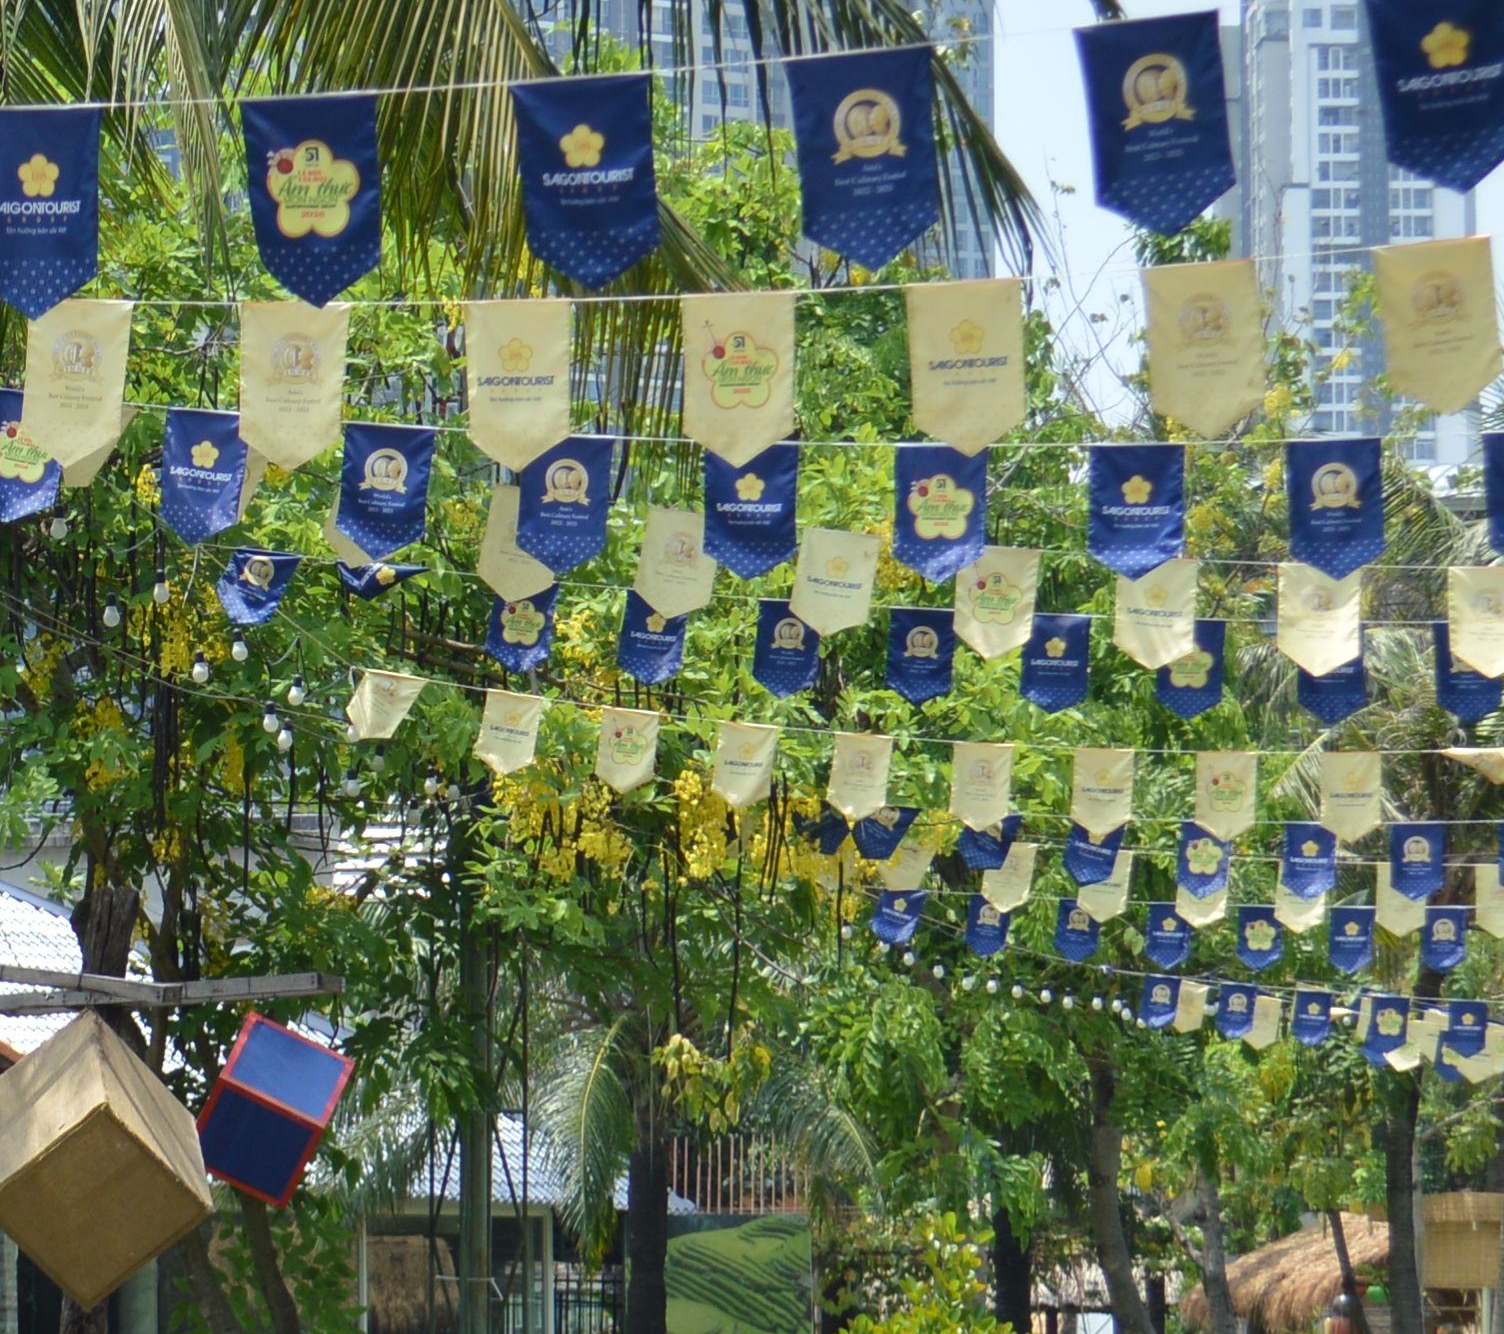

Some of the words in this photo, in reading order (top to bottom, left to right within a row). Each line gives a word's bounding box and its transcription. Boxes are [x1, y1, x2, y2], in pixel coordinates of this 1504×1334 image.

[542, 167, 635, 186] SAIGONTOURIST
[278, 175, 312, 203] Ẩm
[928, 356, 1008, 370] SAIGONTOURIST
[477, 376, 554, 386] SAIGONTOURIST
[170, 466, 233, 481] SAIGONTOURIST
[716, 503, 782, 512] SAIGONTOURIST
[1102, 506, 1171, 515] SAIGONTOURIST
